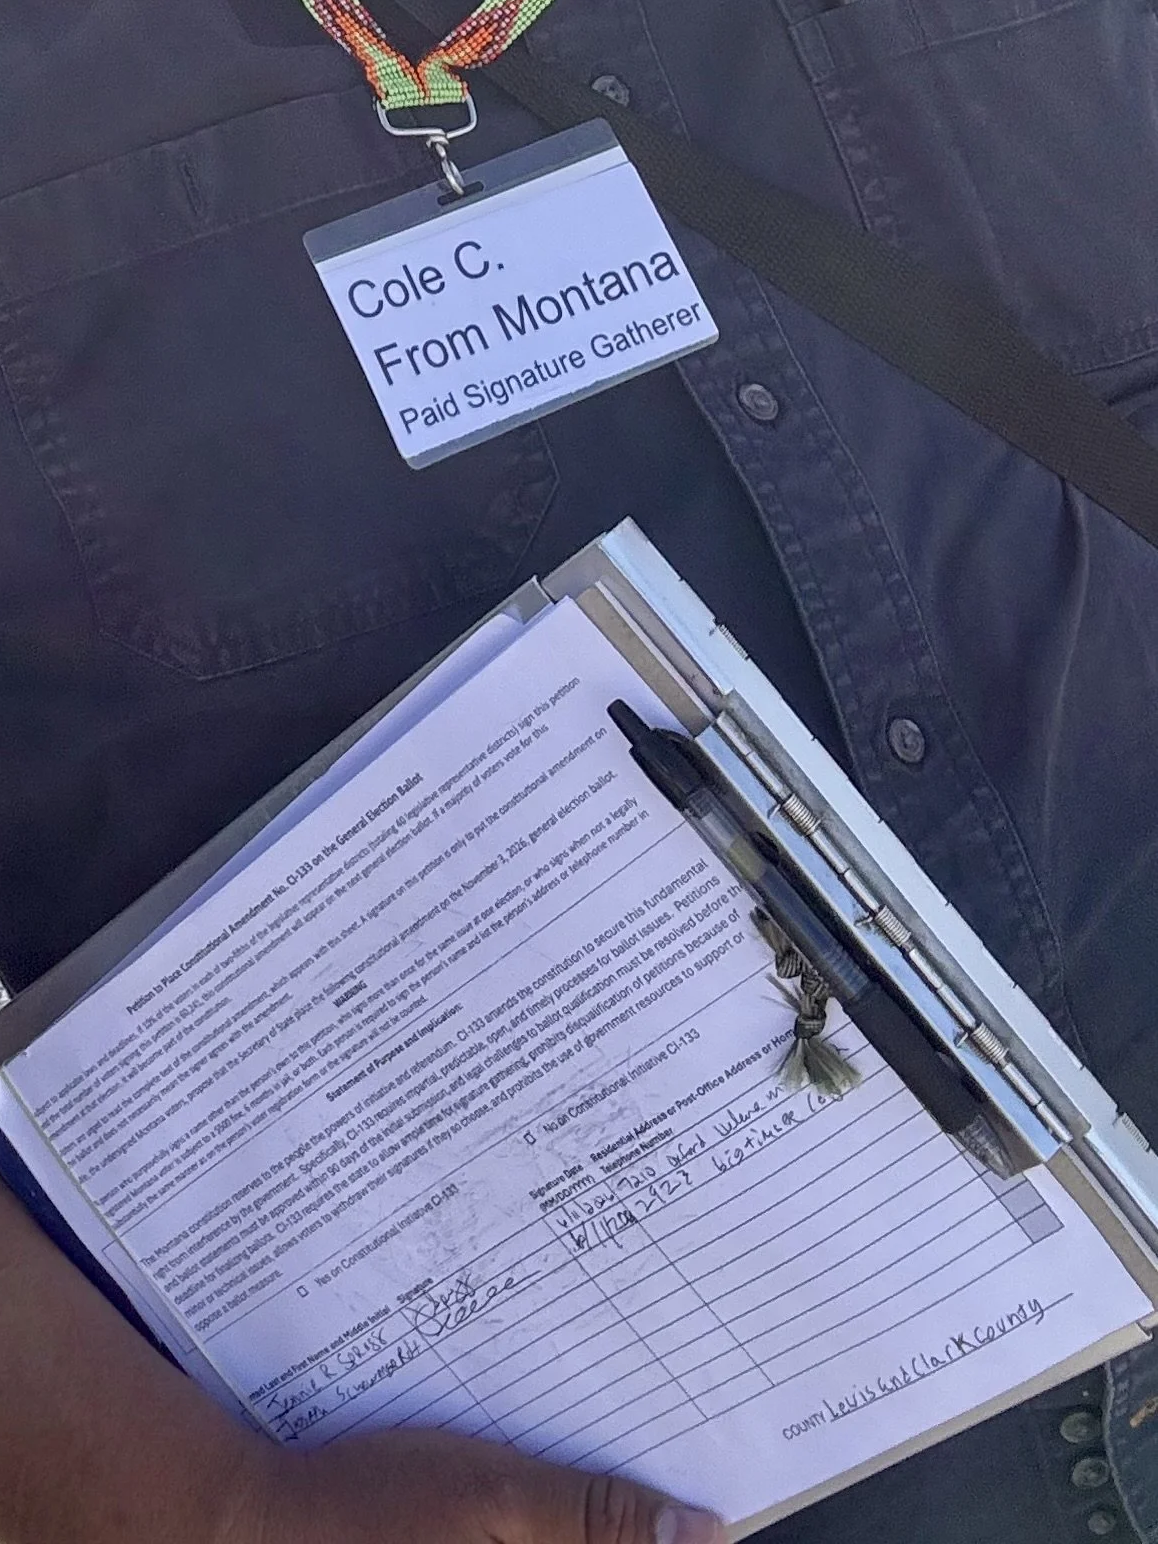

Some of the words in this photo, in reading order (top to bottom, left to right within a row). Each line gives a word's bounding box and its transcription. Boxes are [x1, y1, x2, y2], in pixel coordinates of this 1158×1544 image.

[348, 264, 446, 319] Cole
[453, 240, 506, 280] C.
[374, 327, 489, 386] From
[493, 251, 680, 342] Montana
[399, 397, 461, 434] Paid
[463, 350, 586, 410] Signature
[590, 302, 702, 359] Gatherer
[517, 713, 535, 729] sign
[532, 701, 549, 716] this
[548, 677, 579, 706] petition
[460, 859, 498, 891] November
[528, 813, 558, 843] general
[557, 790, 590, 818] election
[587, 770, 617, 793] ballot.
[125, 991, 155, 1015] Petition
[152, 984, 163, 993] to
[160, 969, 182, 987] Place
[179, 928, 230, 972] Constitutional
[228, 893, 274, 933] Amendment
[271, 885, 289, 897] No.
[285, 861, 313, 885] CI-133
[311, 853, 324, 865] on
[321, 843, 338, 857] the
[335, 815, 368, 845] General
[365, 793, 399, 821] Election
[395, 772, 423, 796] Ballot
[228, 1214, 241, 1224] by
[239, 1204, 254, 1217] the
[252, 1172, 299, 1210] government.
[346, 1116, 375, 1140] CI-133
[373, 1095, 406, 1121] requires
[486, 1025, 512, 1043] open,
[509, 1009, 528, 1028] and
[525, 993, 555, 1016] timely
[552, 963, 598, 1000] processes
[596, 953, 611, 967] for
[609, 933, 640, 957] ballot
[637, 911, 674, 938] issues.
[673, 876, 720, 911] Petitions
[231, 1177, 263, 1202] reserves
[260, 1170, 271, 1180] to
[269, 1161, 284, 1174] the
[283, 1141, 311, 1166] people
[309, 1132, 325, 1145] the
[323, 1110, 355, 1137] powers
[353, 1101, 364, 1113] of
[394, 1069, 411, 1085] and
[409, 1040, 457, 1074] referendum.
[456, 1017, 485, 1041] CI-133
[484, 995, 518, 1023] amends
[516, 985, 533, 999] the
[531, 949, 584, 989] constitution
[581, 942, 594, 954] to
[593, 920, 626, 946] secure
[623, 906, 645, 923] this
[642, 858, 708, 910] fundamental
[257, 1214, 270, 1225] be
[268, 1188, 305, 1218] approved
[303, 1172, 328, 1192] within
[339, 1150, 360, 1167] days
[359, 1141, 369, 1153] of
[367, 1133, 384, 1147] the
[448, 1075, 466, 1091] and
[462, 1063, 485, 1080] legal
[483, 1034, 528, 1068] challenges
[525, 1027, 538, 1038] to
[534, 1009, 563, 1032] ballot
[561, 974, 617, 1014] qualification
[615, 956, 642, 977] must
[638, 947, 655, 961] be
[653, 916, 696, 951] resolved
[693, 894, 728, 922] before
[275, 1210, 303, 1233] CI-133
[301, 1190, 335, 1216] requires
[332, 1179, 349, 1193] the
[347, 1165, 370, 1183] state
[367, 1158, 379, 1168] to
[378, 1142, 400, 1161] allow
[528, 1031, 566, 1061] prohibits
[565, 985, 633, 1034] disqualification
[632, 975, 644, 989] of
[642, 949, 686, 984] petitions
[683, 919, 728, 953] because
[728, 907, 739, 922] of
[320, 1213, 332, 1223] to
[330, 1187, 368, 1216] withdraw
[366, 1172, 387, 1190] their
[386, 1145, 428, 1177] signatures
[431, 1129, 451, 1144] they
[449, 1122, 462, 1133] so
[490, 1090, 508, 1107] and
[506, 1068, 544, 1098] prohibits
[540, 1059, 558, 1073] the
[556, 1048, 574, 1063] use
[573, 1038, 584, 1052] of
[583, 1006, 637, 1048] government
[635, 975, 683, 1011] resources
[681, 967, 694, 978] to
[693, 939, 733, 971] support
[732, 931, 744, 944] or
[325, 1069, 367, 1102] Statement
[366, 1062, 375, 1073] of
[373, 1044, 404, 1068] Purpose
[403, 1032, 419, 1048] and
[542, 1121, 558, 1132] No
[556, 1113, 570, 1126] on
[567, 1074, 630, 1117] Constitutional
[627, 1051, 668, 1080] Initiative
[665, 1028, 700, 1054] CI-133
[589, 1131, 635, 1162] Residential
[633, 1112, 667, 1138] Address
[666, 1105, 676, 1115] or
[674, 1075, 724, 1109] Post-Office
[724, 1051, 761, 1079] Address
[761, 1043, 771, 1054] or
[599, 1147, 640, 1179] Telephone
[638, 1127, 672, 1151] Number
[562, 1164, 583, 1178] Date
[313, 1273, 331, 1286] Yes
[330, 1265, 343, 1277] on
[340, 1224, 401, 1269] Constitutional
[396, 1202, 433, 1229] Initiative
[430, 1183, 458, 1206] CI-133
[396, 1277, 437, 1307] Signature
[782, 1410, 827, 1440] COUNTY
